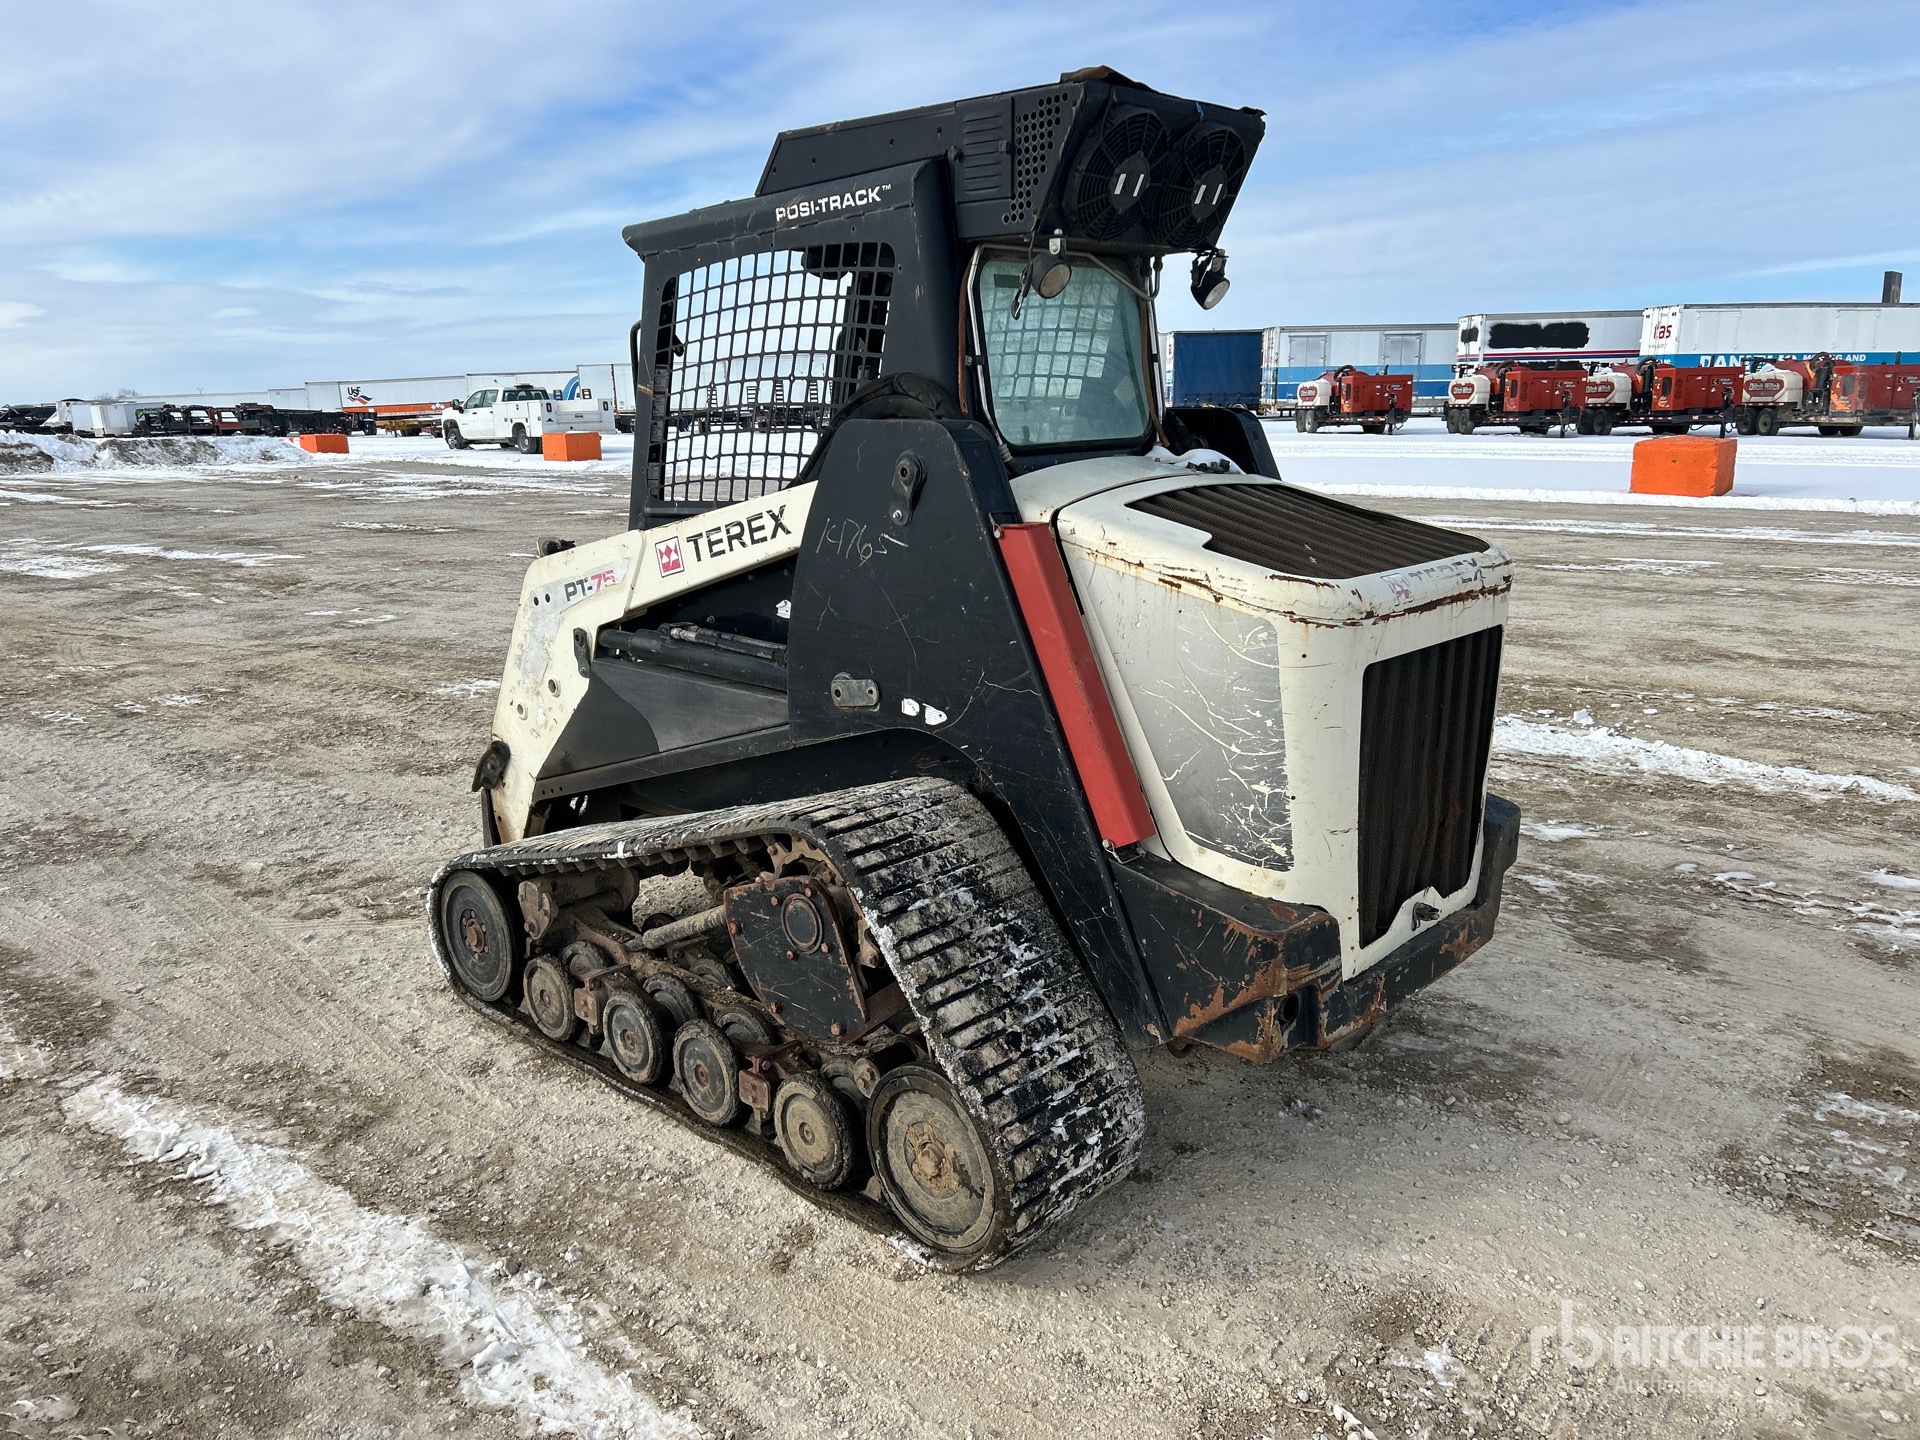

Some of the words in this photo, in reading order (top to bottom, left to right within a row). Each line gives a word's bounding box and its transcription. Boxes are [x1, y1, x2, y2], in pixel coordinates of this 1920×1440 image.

[347, 386, 361, 397] USF
[686, 504, 793, 562] TEREX
[564, 569, 616, 602] PT-75
